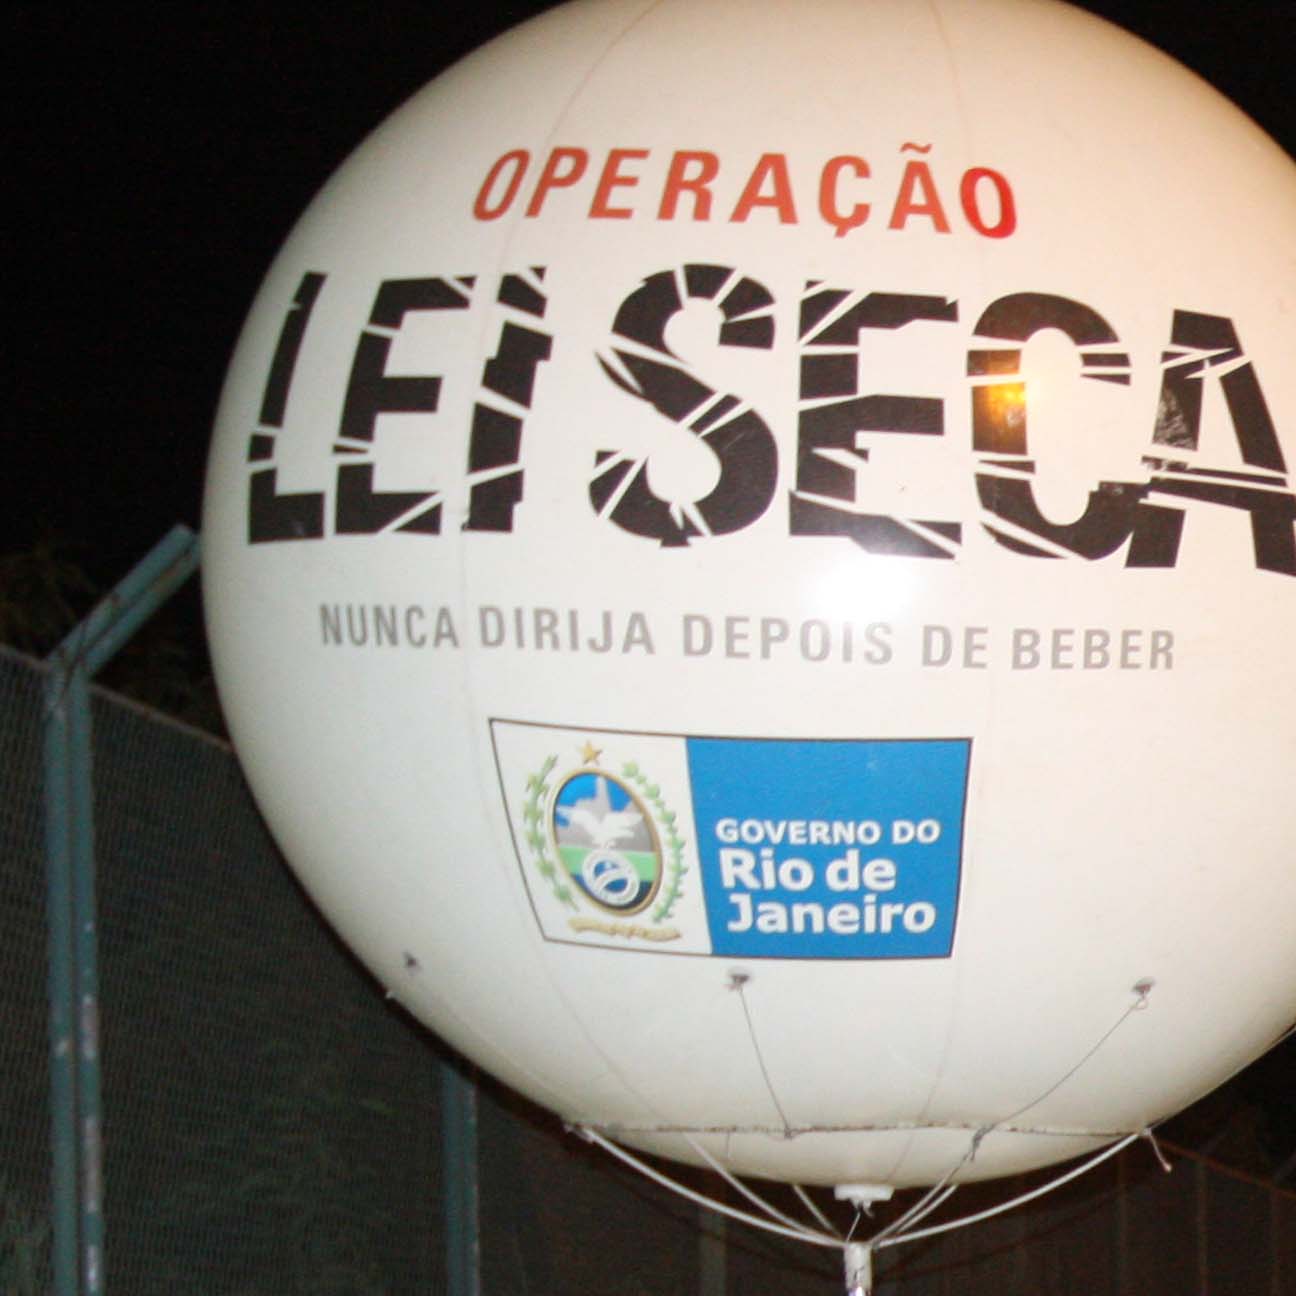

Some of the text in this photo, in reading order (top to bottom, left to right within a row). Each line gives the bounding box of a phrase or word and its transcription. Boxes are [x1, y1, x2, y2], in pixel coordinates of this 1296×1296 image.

[472, 142, 1018, 239] OPERAÇÃO
[247, 266, 553, 544] LEI
[319, 602, 1177, 672] NUNCA DIRIJA DEPOIS DE BEBER
[715, 818, 941, 845] GOVERNO DO
[719, 848, 896, 891] Rio de
[727, 894, 937, 935] Janeiro
